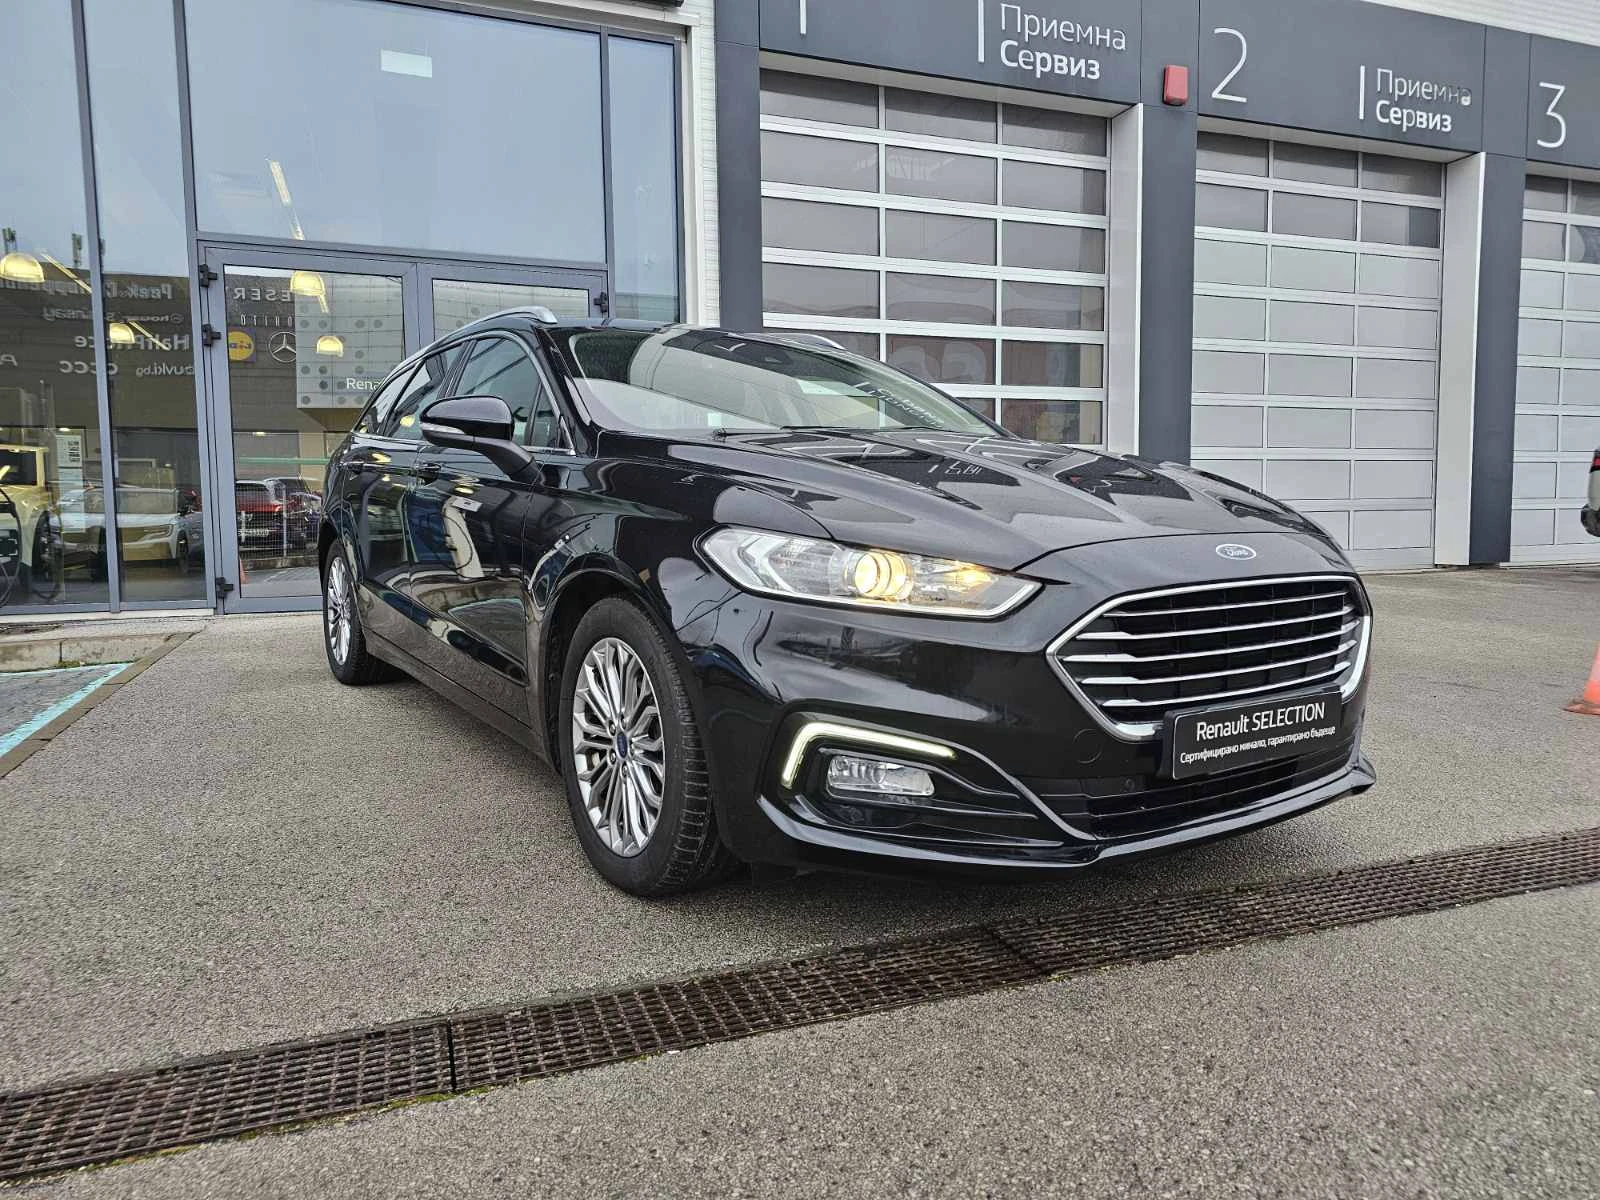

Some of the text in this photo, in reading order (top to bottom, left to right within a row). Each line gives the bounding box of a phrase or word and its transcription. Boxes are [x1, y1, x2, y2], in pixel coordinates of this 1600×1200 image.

[1001, 3, 1127, 51] Приемна
[1000, 40, 1101, 81] Сервиз
[1211, 27, 1249, 104] 2
[1376, 68, 1472, 107] Приемна
[1375, 100, 1452, 133] Сервиз
[1536, 82, 1567, 149] 3
[346, 377, 381, 391] Rena
[1196, 701, 1325, 741] Renault SELECTION
[1180, 744, 1239, 764] Сертифицирано
[1267, 731, 1310, 747] гарантирано
